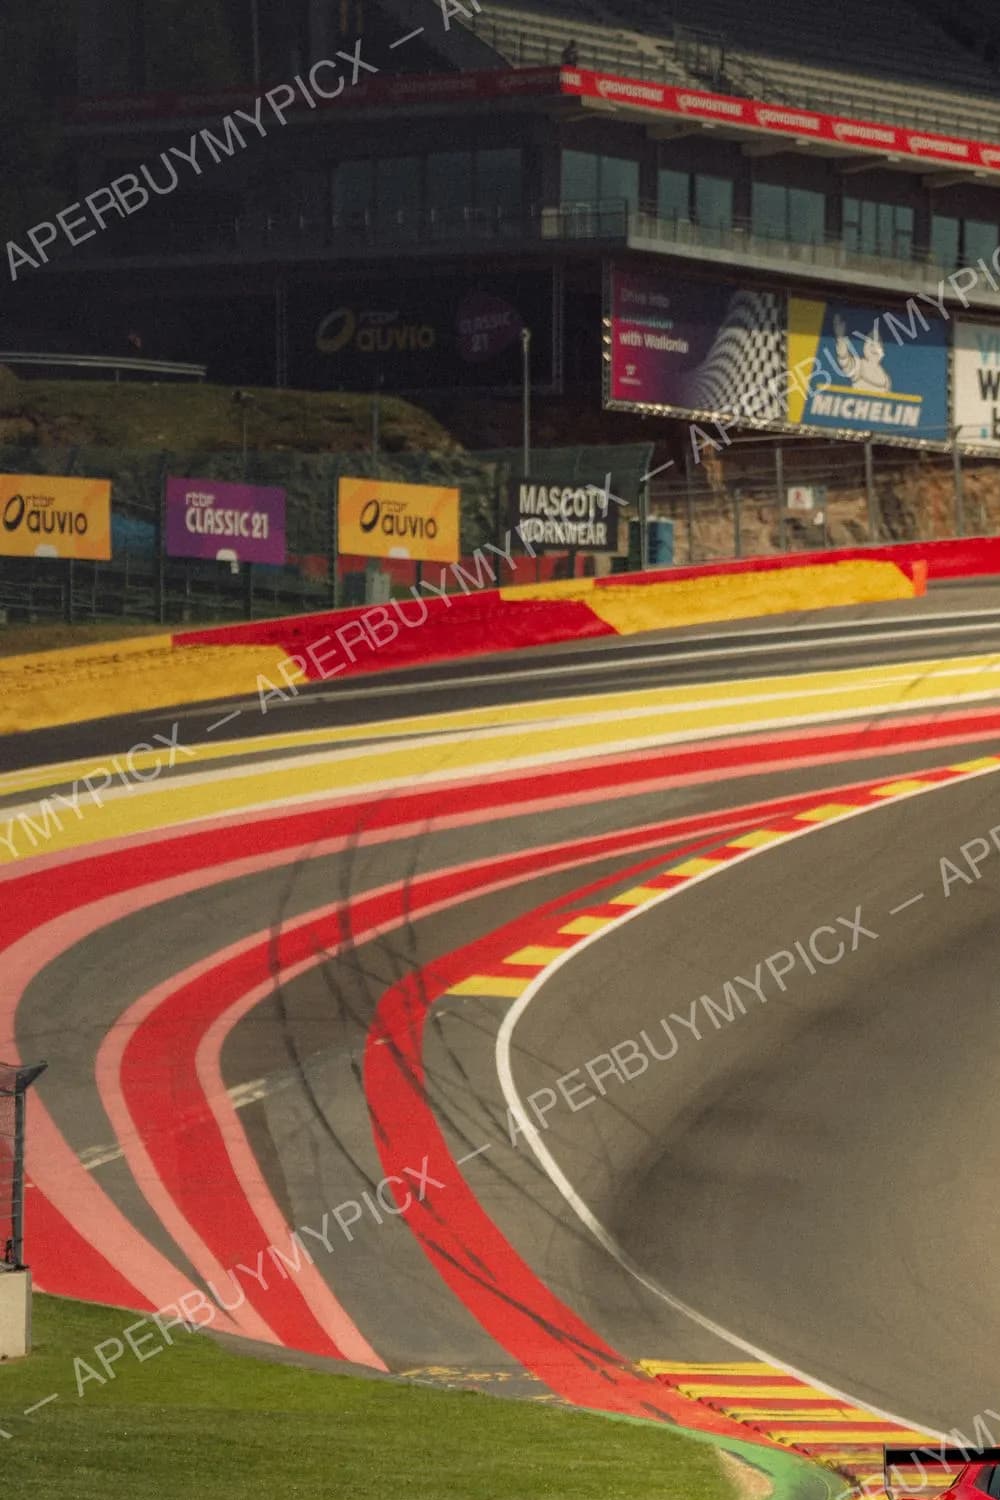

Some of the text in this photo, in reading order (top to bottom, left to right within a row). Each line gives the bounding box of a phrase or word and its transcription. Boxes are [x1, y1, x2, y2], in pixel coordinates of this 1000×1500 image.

[811, 393, 921, 428] MICHELIN
[26, 509, 88, 536] auvio
[186, 507, 269, 539] CLASSIC 21
[381, 514, 437, 539] auvio
